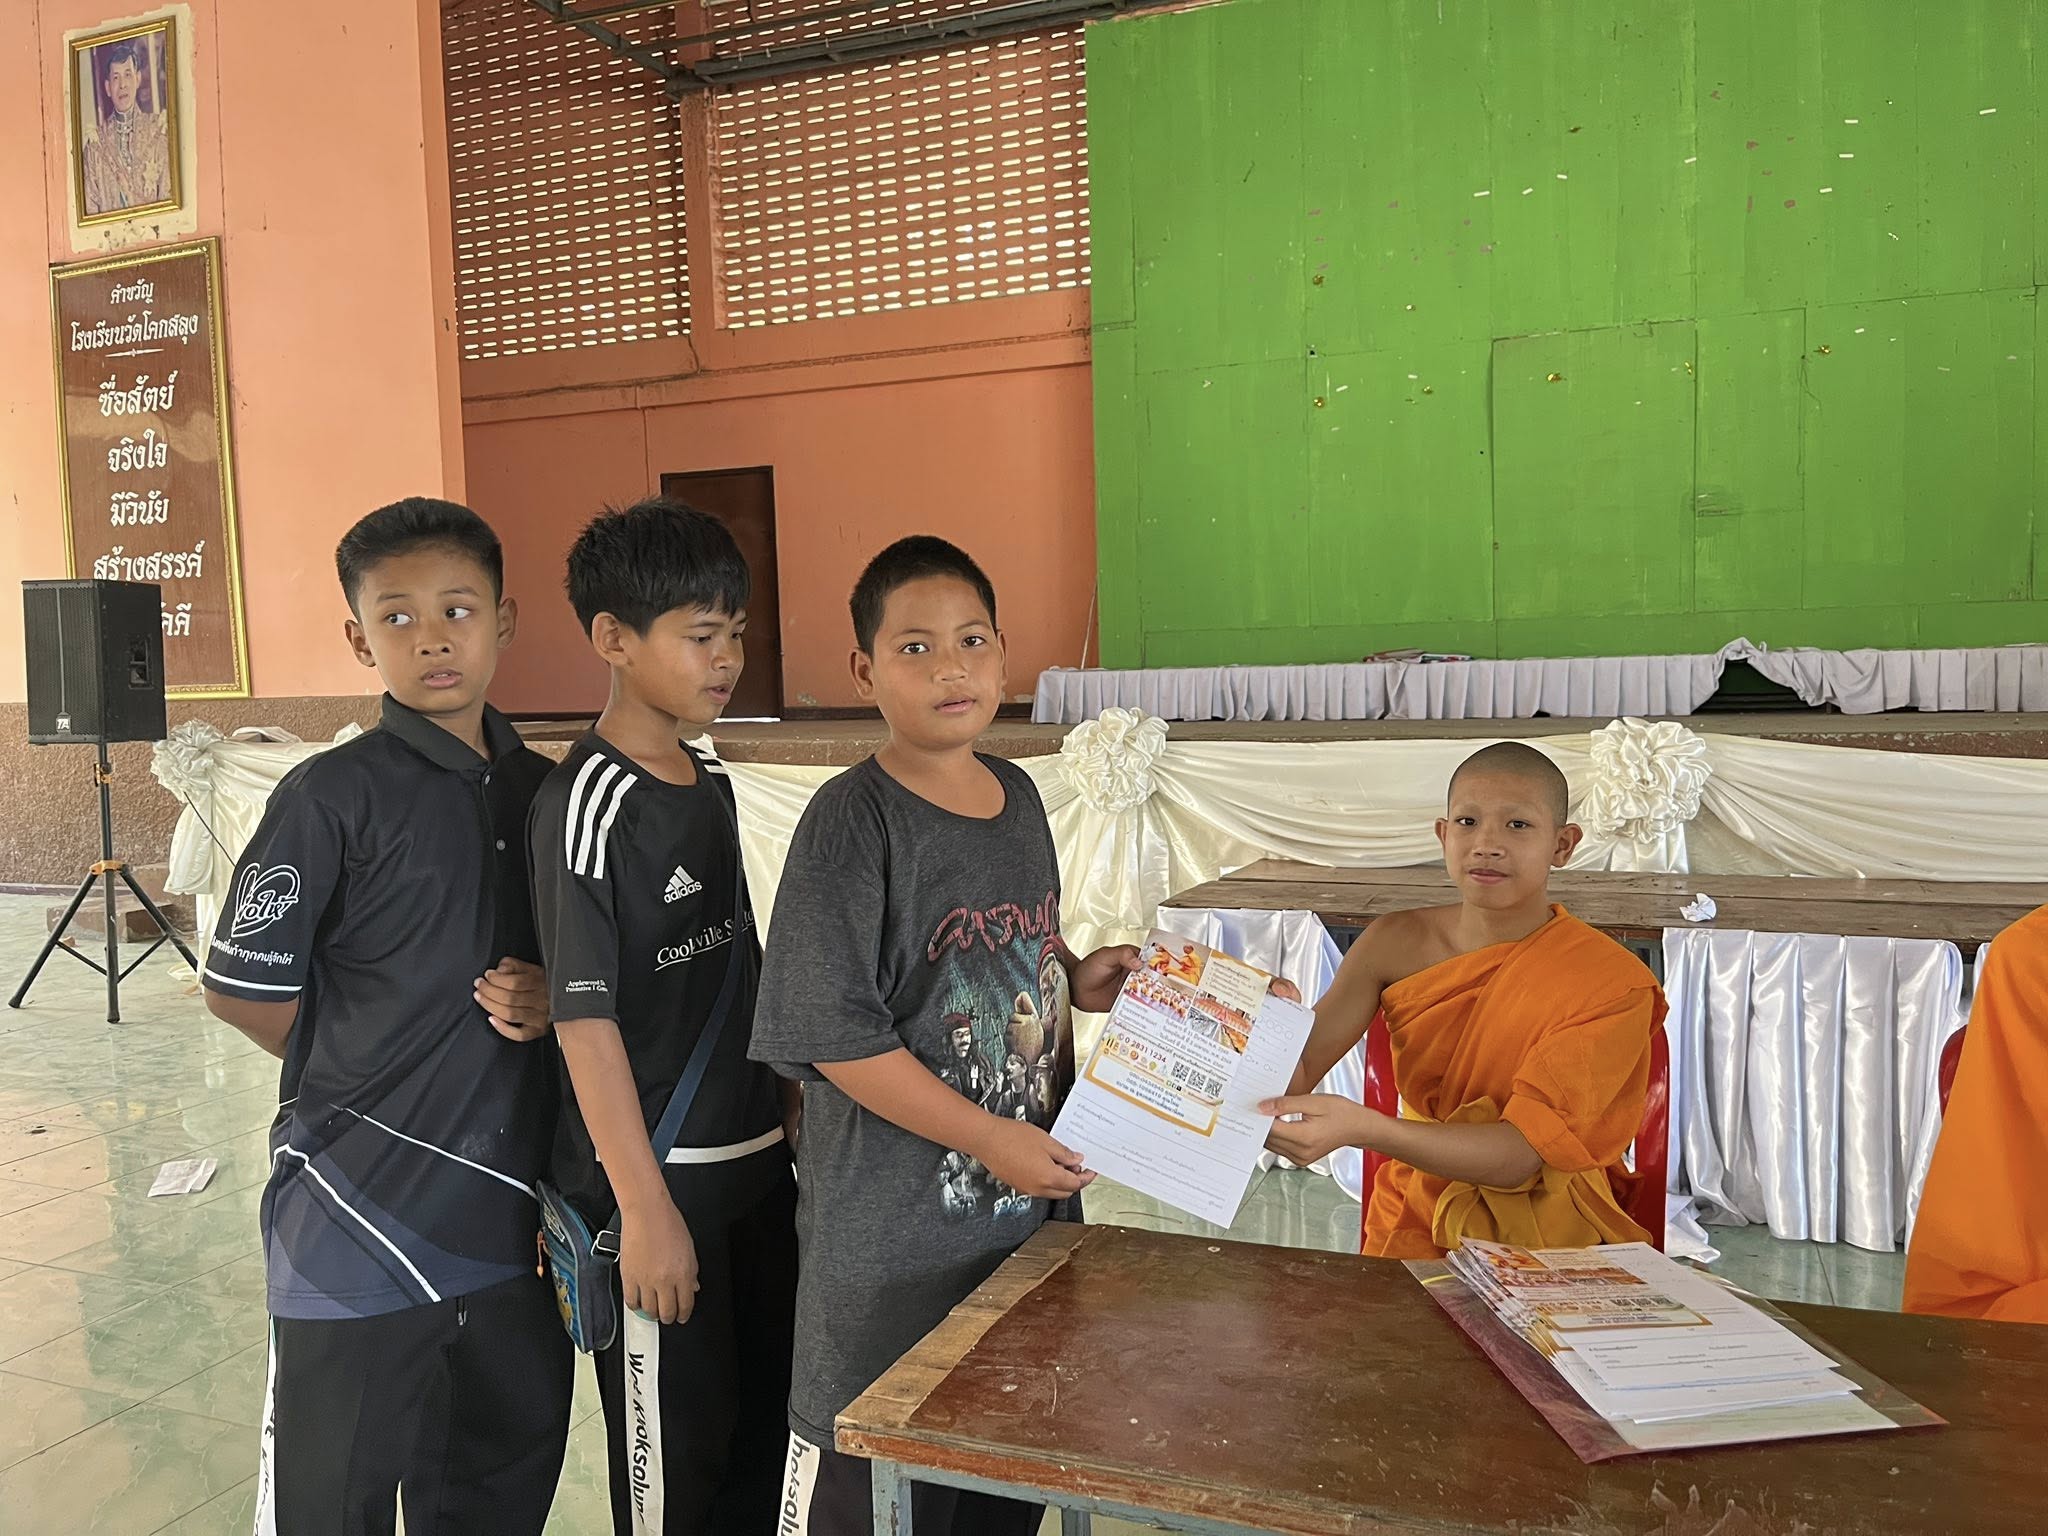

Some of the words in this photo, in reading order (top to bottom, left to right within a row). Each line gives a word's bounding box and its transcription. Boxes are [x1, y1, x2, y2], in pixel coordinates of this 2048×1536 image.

[110, 281, 154, 305] คำขวัญ
[71, 311, 198, 352] โรงเรียนวัดโคกสลุง
[98, 370, 178, 417] ซื่อสัตย์
[107, 428, 168, 473] จริงใจ
[109, 489, 169, 528] มีวินัย
[93, 540, 205, 582] สร้างสรรค์
[663, 881, 703, 904] adidas
